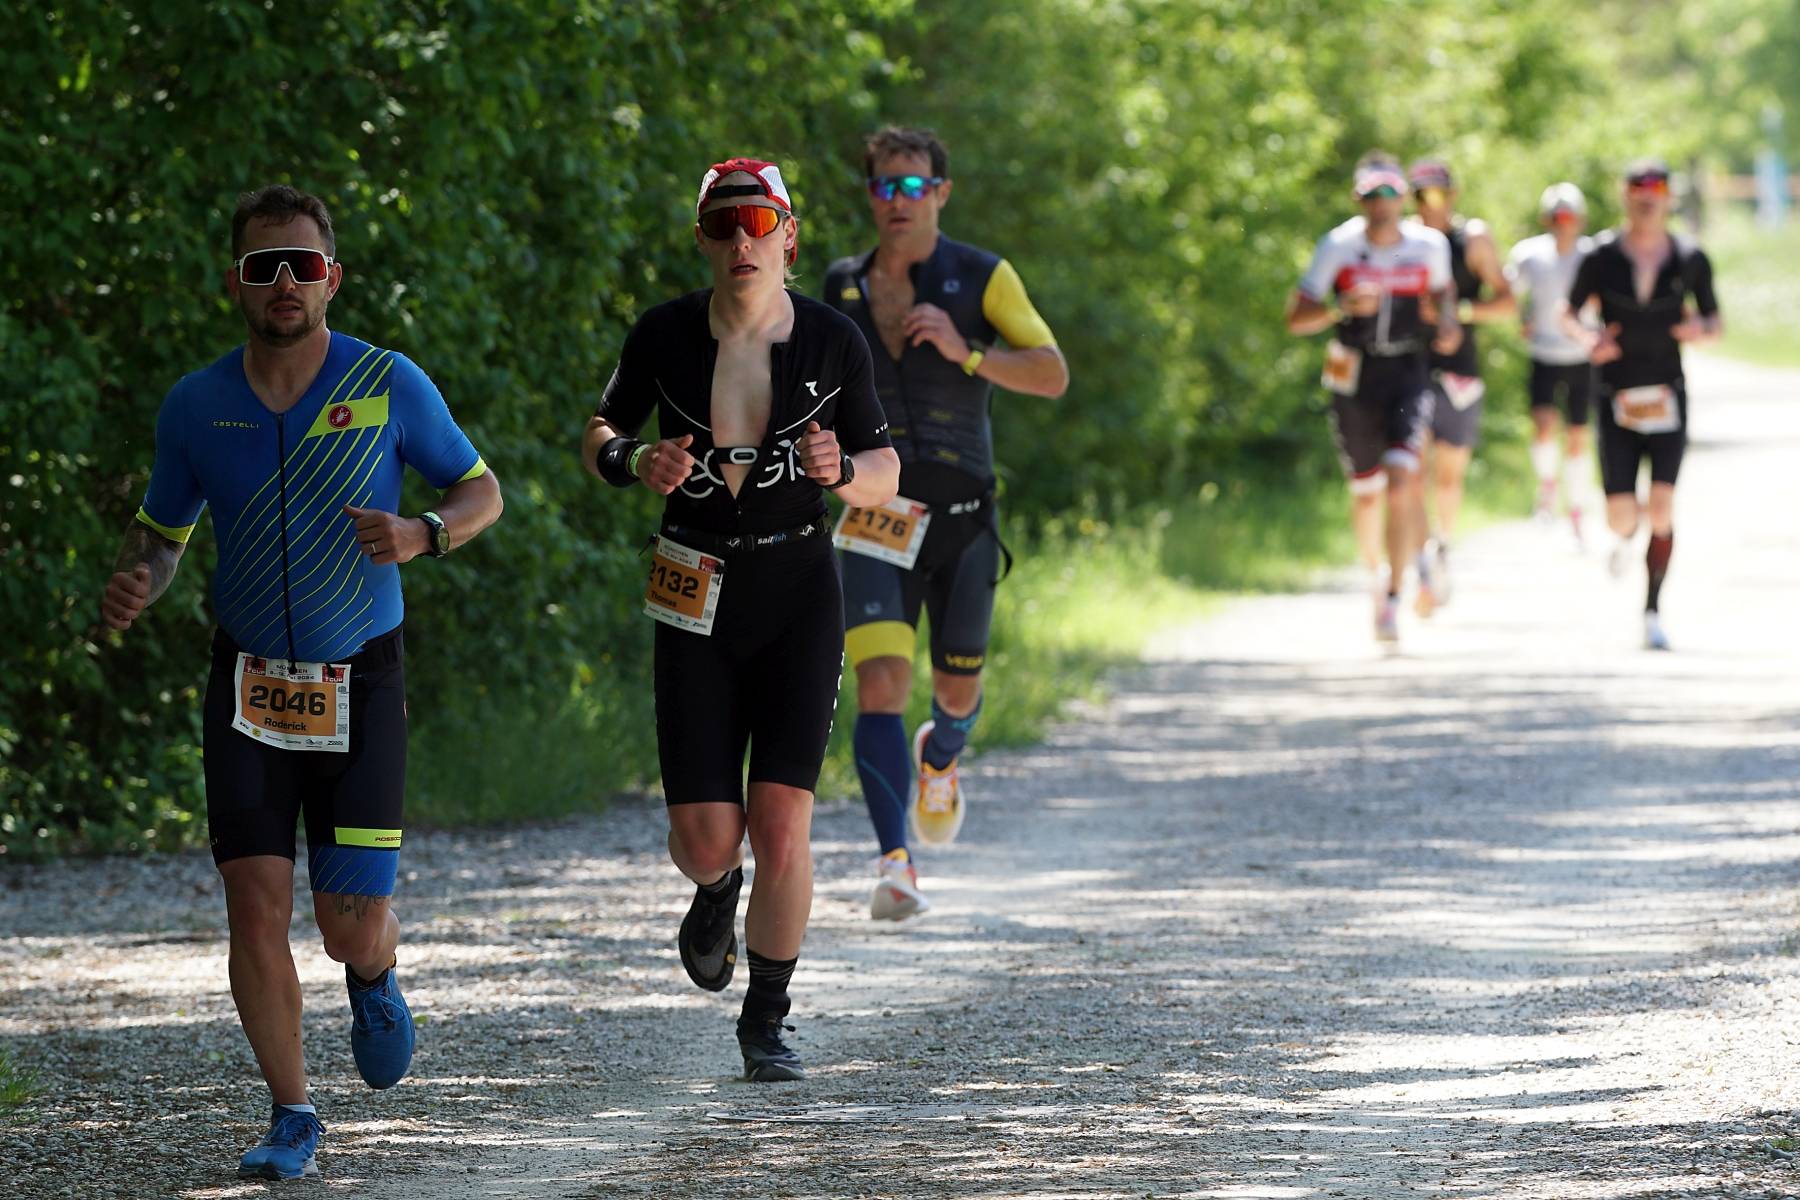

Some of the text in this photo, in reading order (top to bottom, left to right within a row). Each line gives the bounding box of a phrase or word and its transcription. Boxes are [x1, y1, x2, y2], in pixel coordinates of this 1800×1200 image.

[212, 421, 259, 429] CASTELLI
[248, 685, 326, 717] 2046
[264, 717, 307, 731] Roderick
